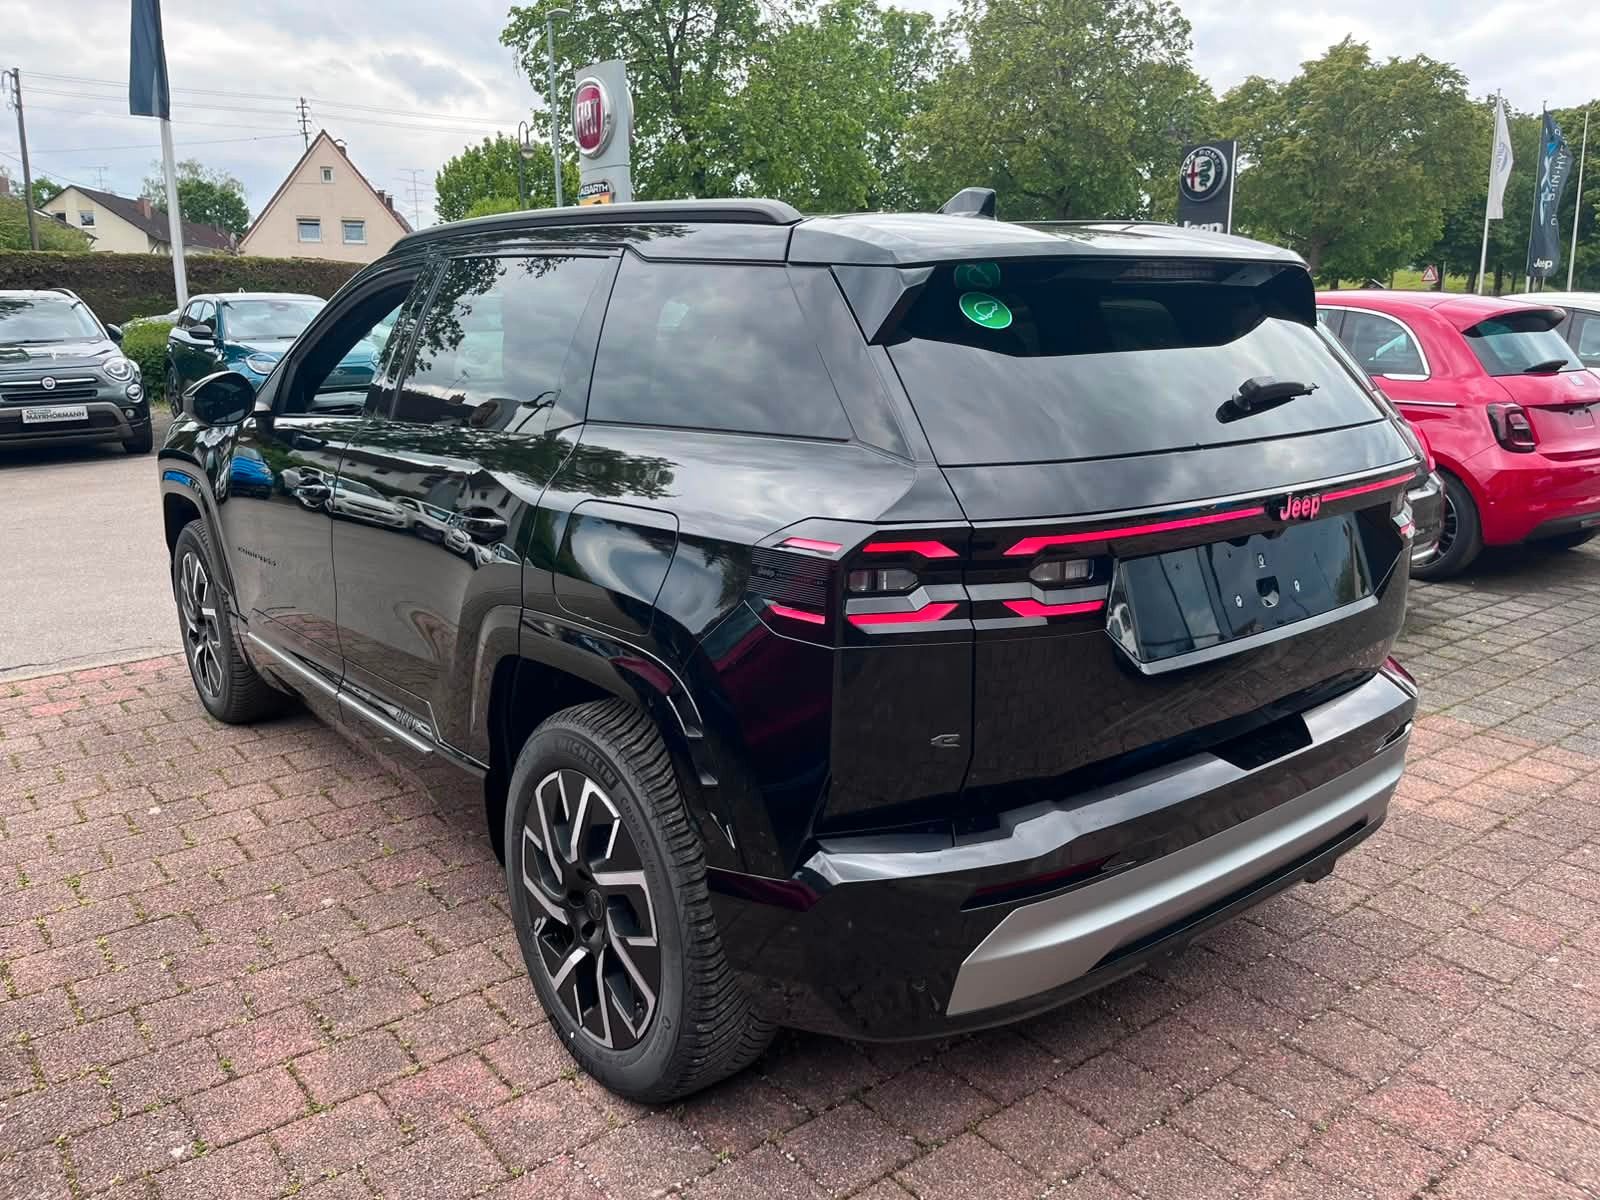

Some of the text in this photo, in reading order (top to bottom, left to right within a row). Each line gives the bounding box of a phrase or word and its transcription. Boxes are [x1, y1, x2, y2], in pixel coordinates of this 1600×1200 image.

[577, 98, 600, 137] FIAT
[580, 183, 609, 195] ABARTH
[1533, 258, 1553, 269] Jeep
[1280, 492, 1320, 520] Jeep
[554, 738, 617, 787] MICHELIN
